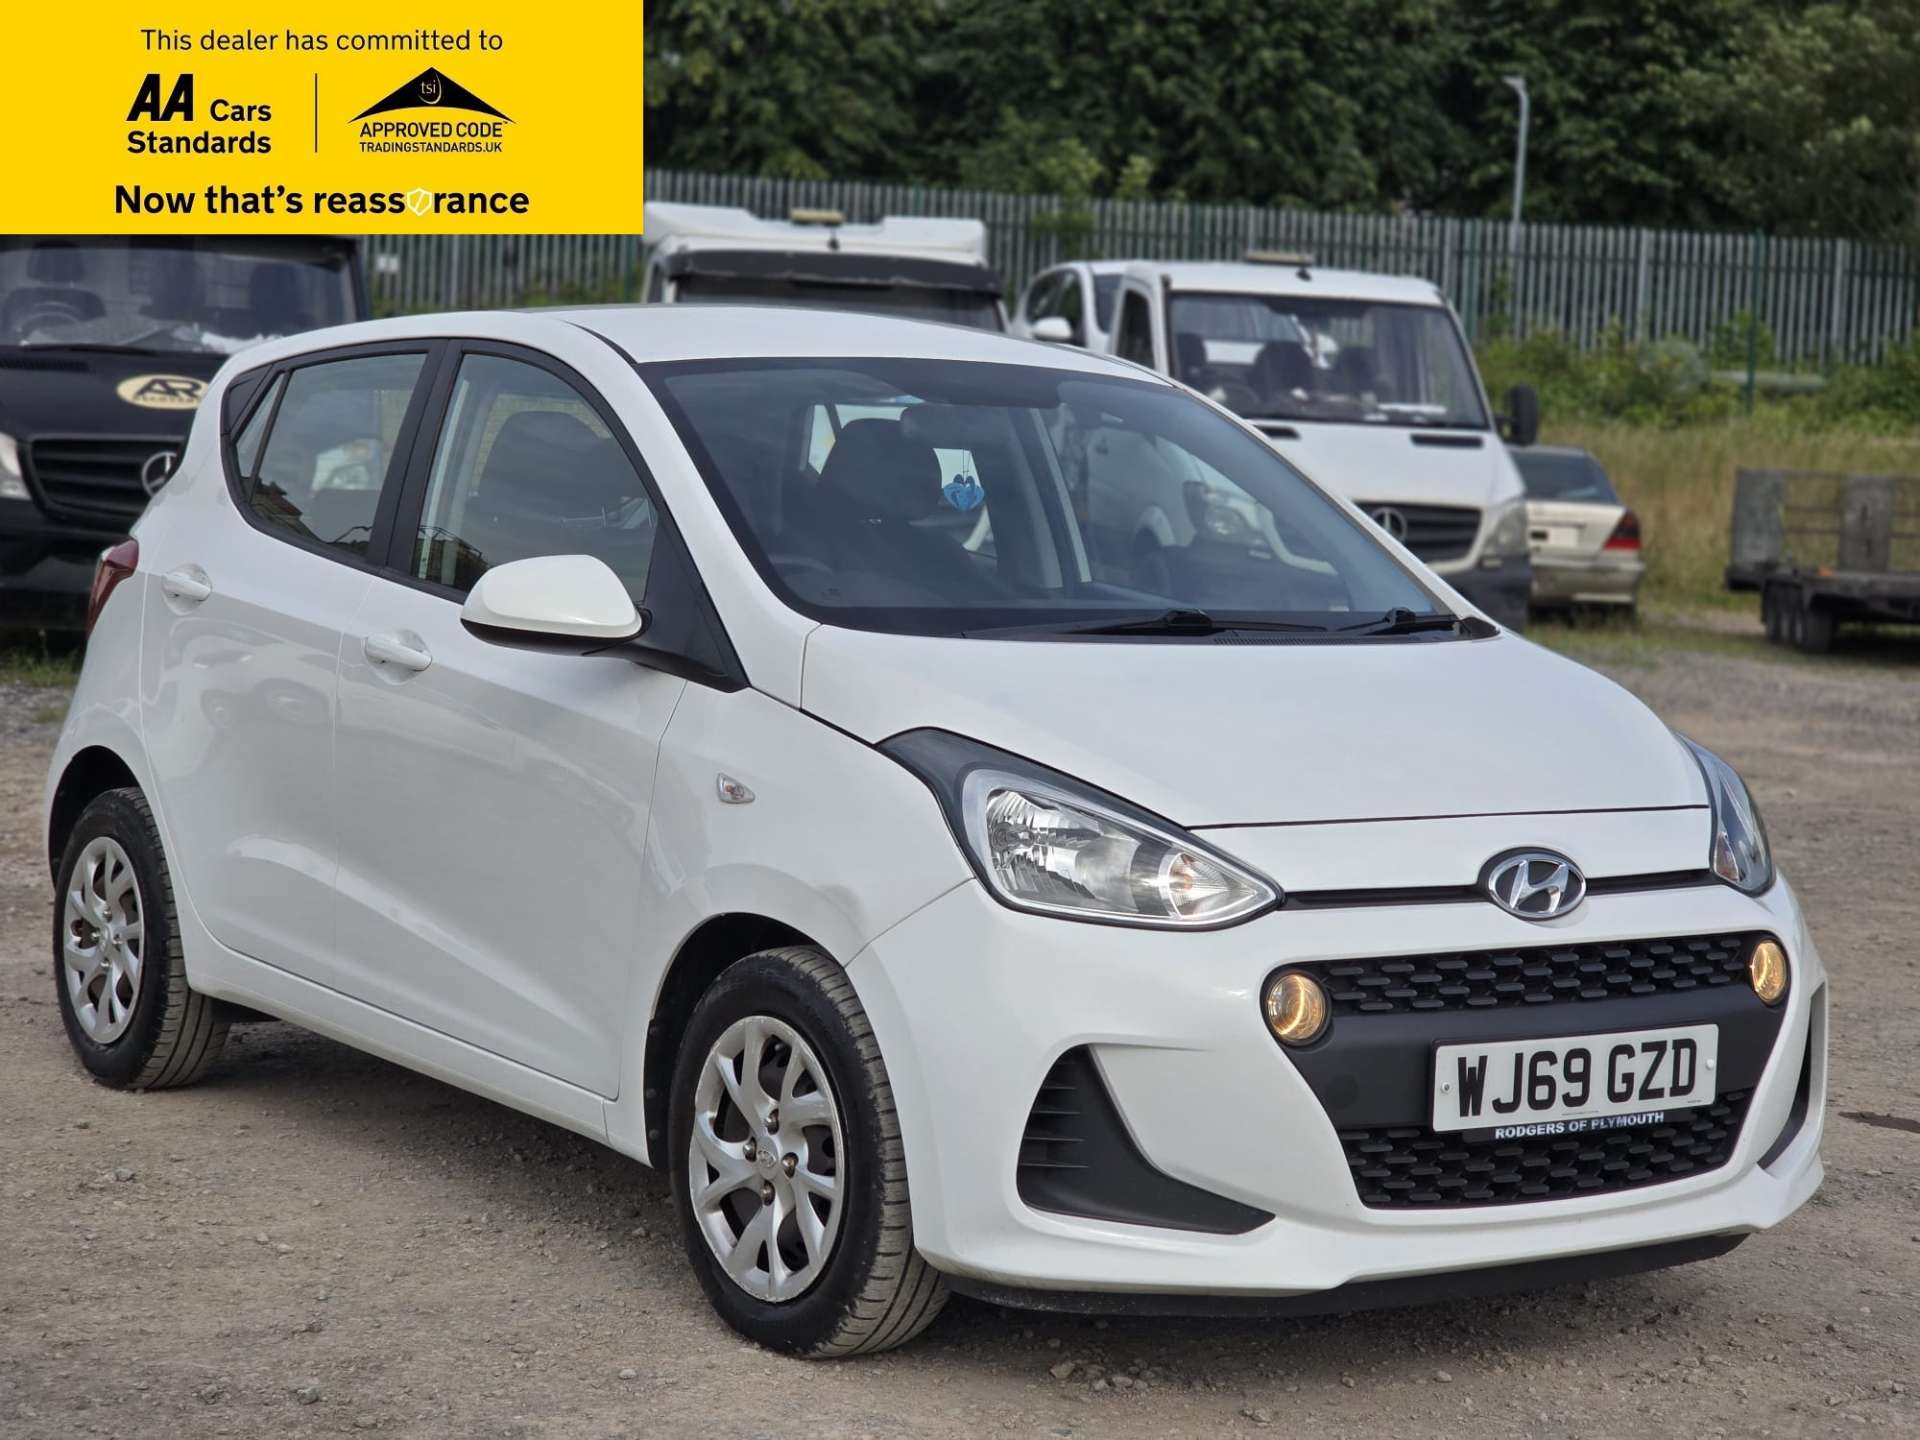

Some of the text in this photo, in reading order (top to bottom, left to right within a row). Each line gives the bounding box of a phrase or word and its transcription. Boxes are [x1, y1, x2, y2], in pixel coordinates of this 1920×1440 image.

[1457, 1038, 1698, 1118] WJ69 GZD
[1495, 1122, 1566, 1140] RODGERS
[1568, 1119, 1588, 1132] OF
[1590, 1111, 1665, 1130] PLYMOUTH
